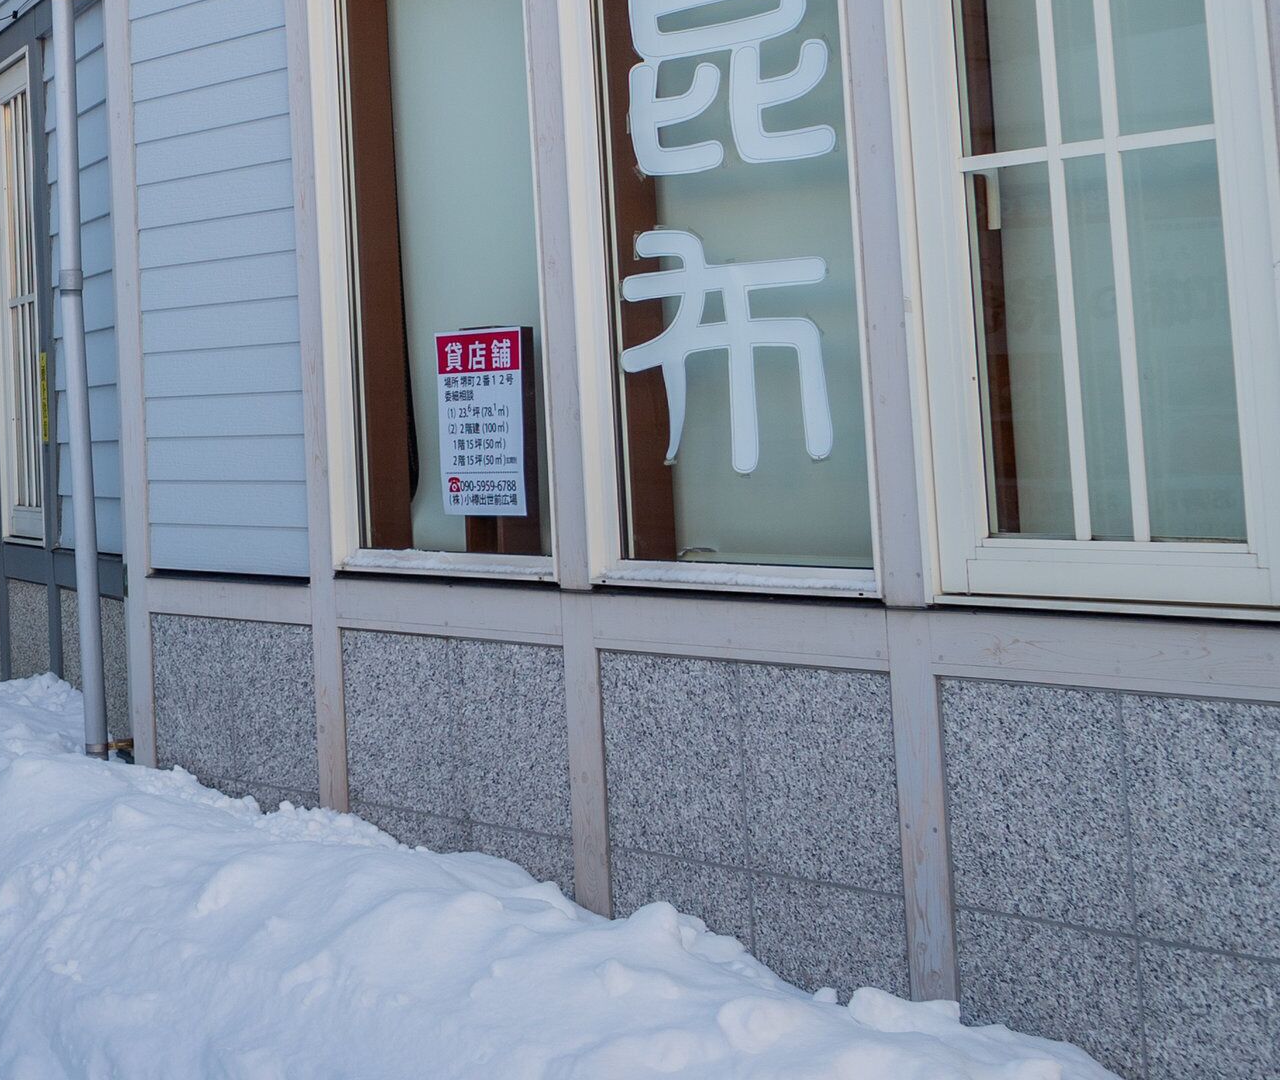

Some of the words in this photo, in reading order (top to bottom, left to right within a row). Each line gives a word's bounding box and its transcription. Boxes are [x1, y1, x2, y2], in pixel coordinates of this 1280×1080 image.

[444, 338, 512, 372] 貸店舗
[444, 389, 475, 403] 委細相談
[460, 479, 517, 492] 090-5959-6788
